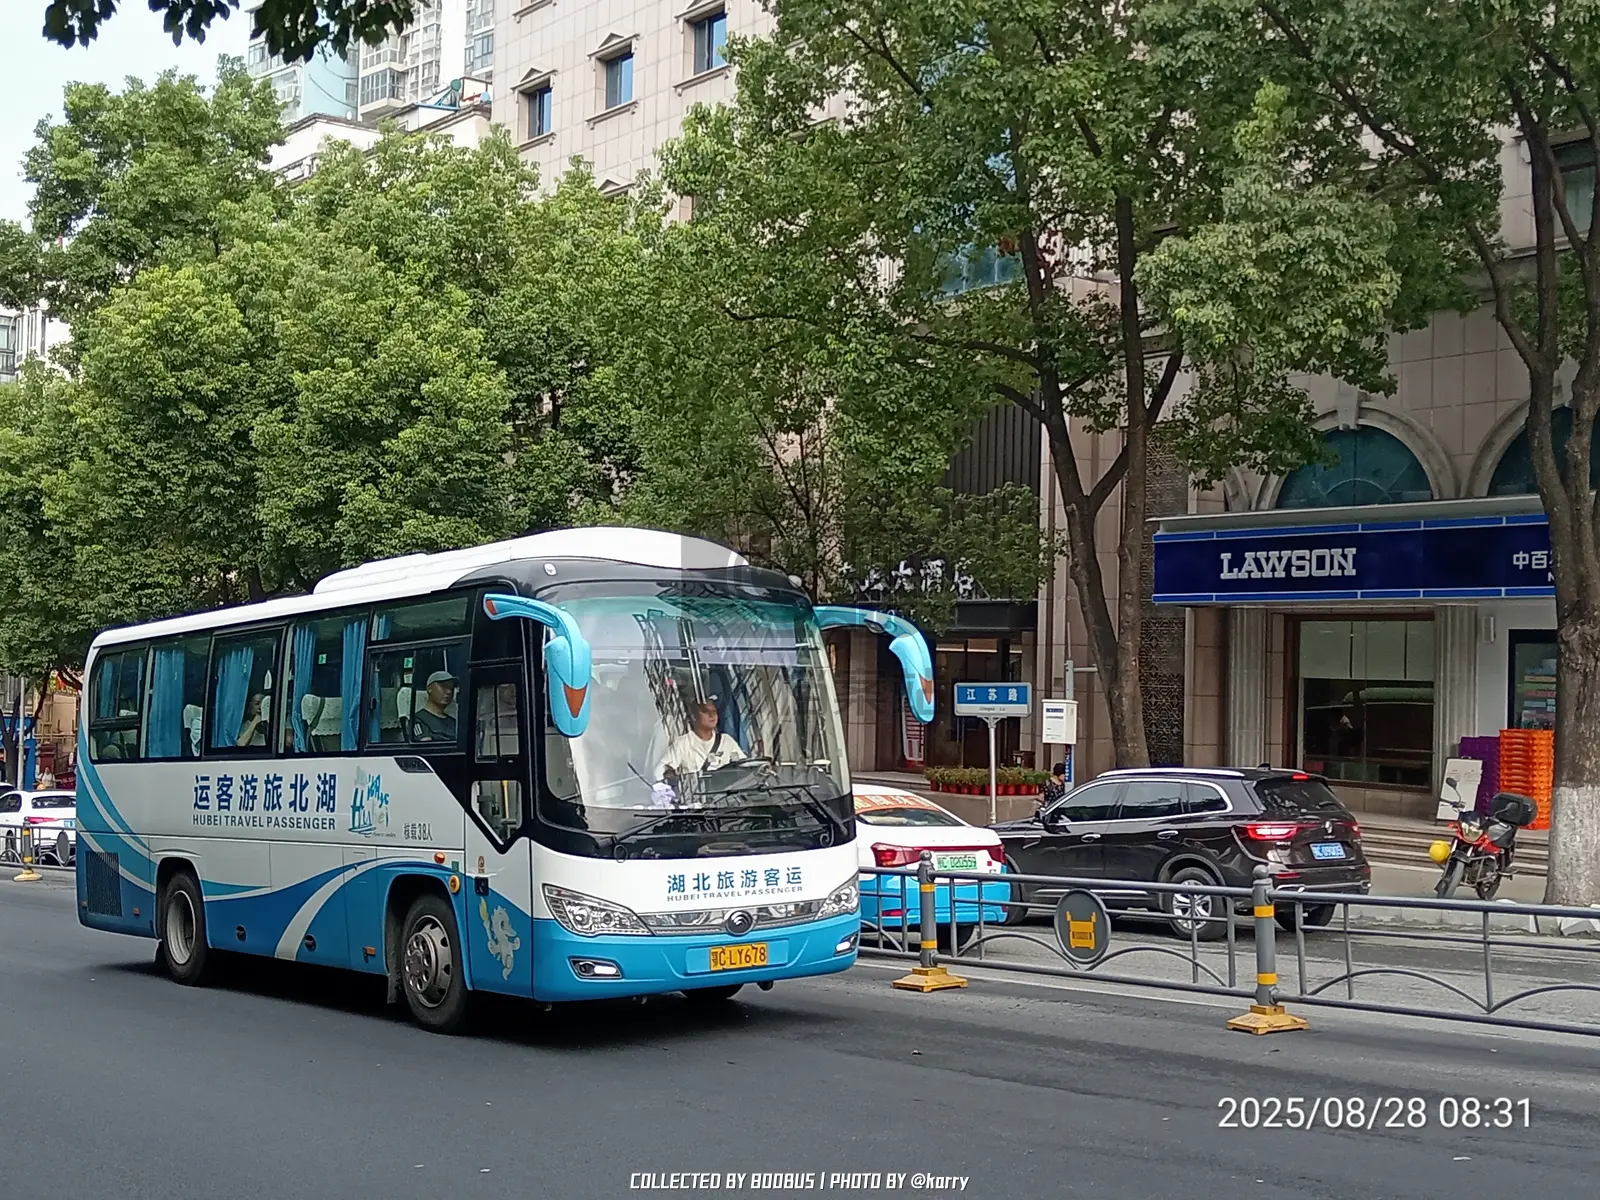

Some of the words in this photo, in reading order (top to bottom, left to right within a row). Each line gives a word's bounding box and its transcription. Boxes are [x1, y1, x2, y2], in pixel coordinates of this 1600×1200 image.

[1220, 548, 1357, 580] LAWSON
[1512, 550, 1553, 570] 中百
[966, 688, 1018, 701] 江苏路
[192, 815, 222, 826] HUBEI
[224, 815, 264, 828] TRAVEL
[267, 816, 336, 830] PASSENGER
[667, 866, 803, 894] 湖北旅游客运
[666, 894, 700, 902] HUBEI
[703, 891, 742, 899] TRAVEL
[745, 886, 803, 896] PASSENGER
